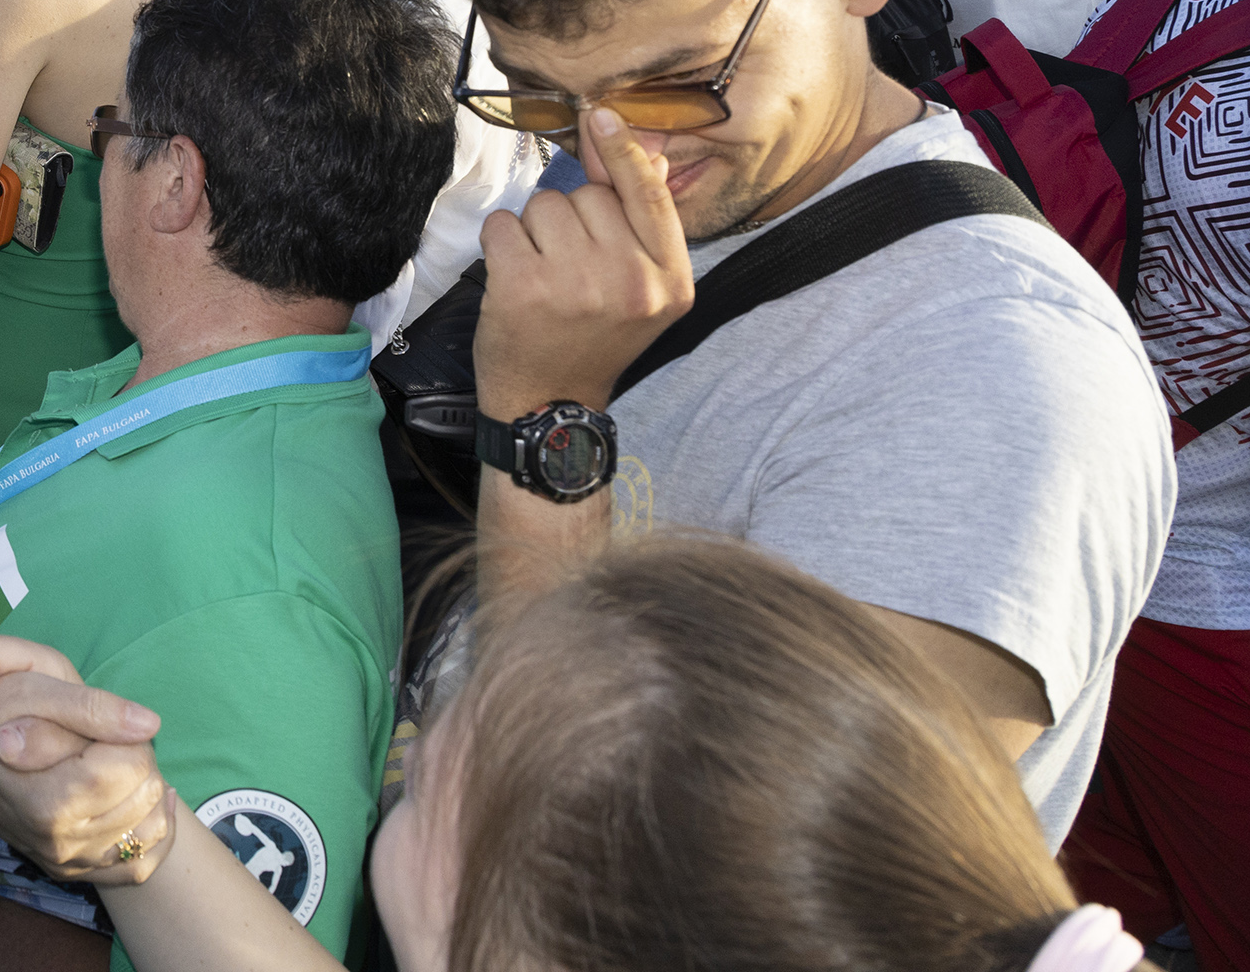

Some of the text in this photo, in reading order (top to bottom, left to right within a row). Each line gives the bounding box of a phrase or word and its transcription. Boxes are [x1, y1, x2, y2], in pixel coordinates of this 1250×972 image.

[75, 407, 152, 448] FAPA BULGARIA
[19, 452, 61, 478] BULGARIA
[206, 796, 322, 919] OF ADAPTED PHYSICAL ACTIVI
